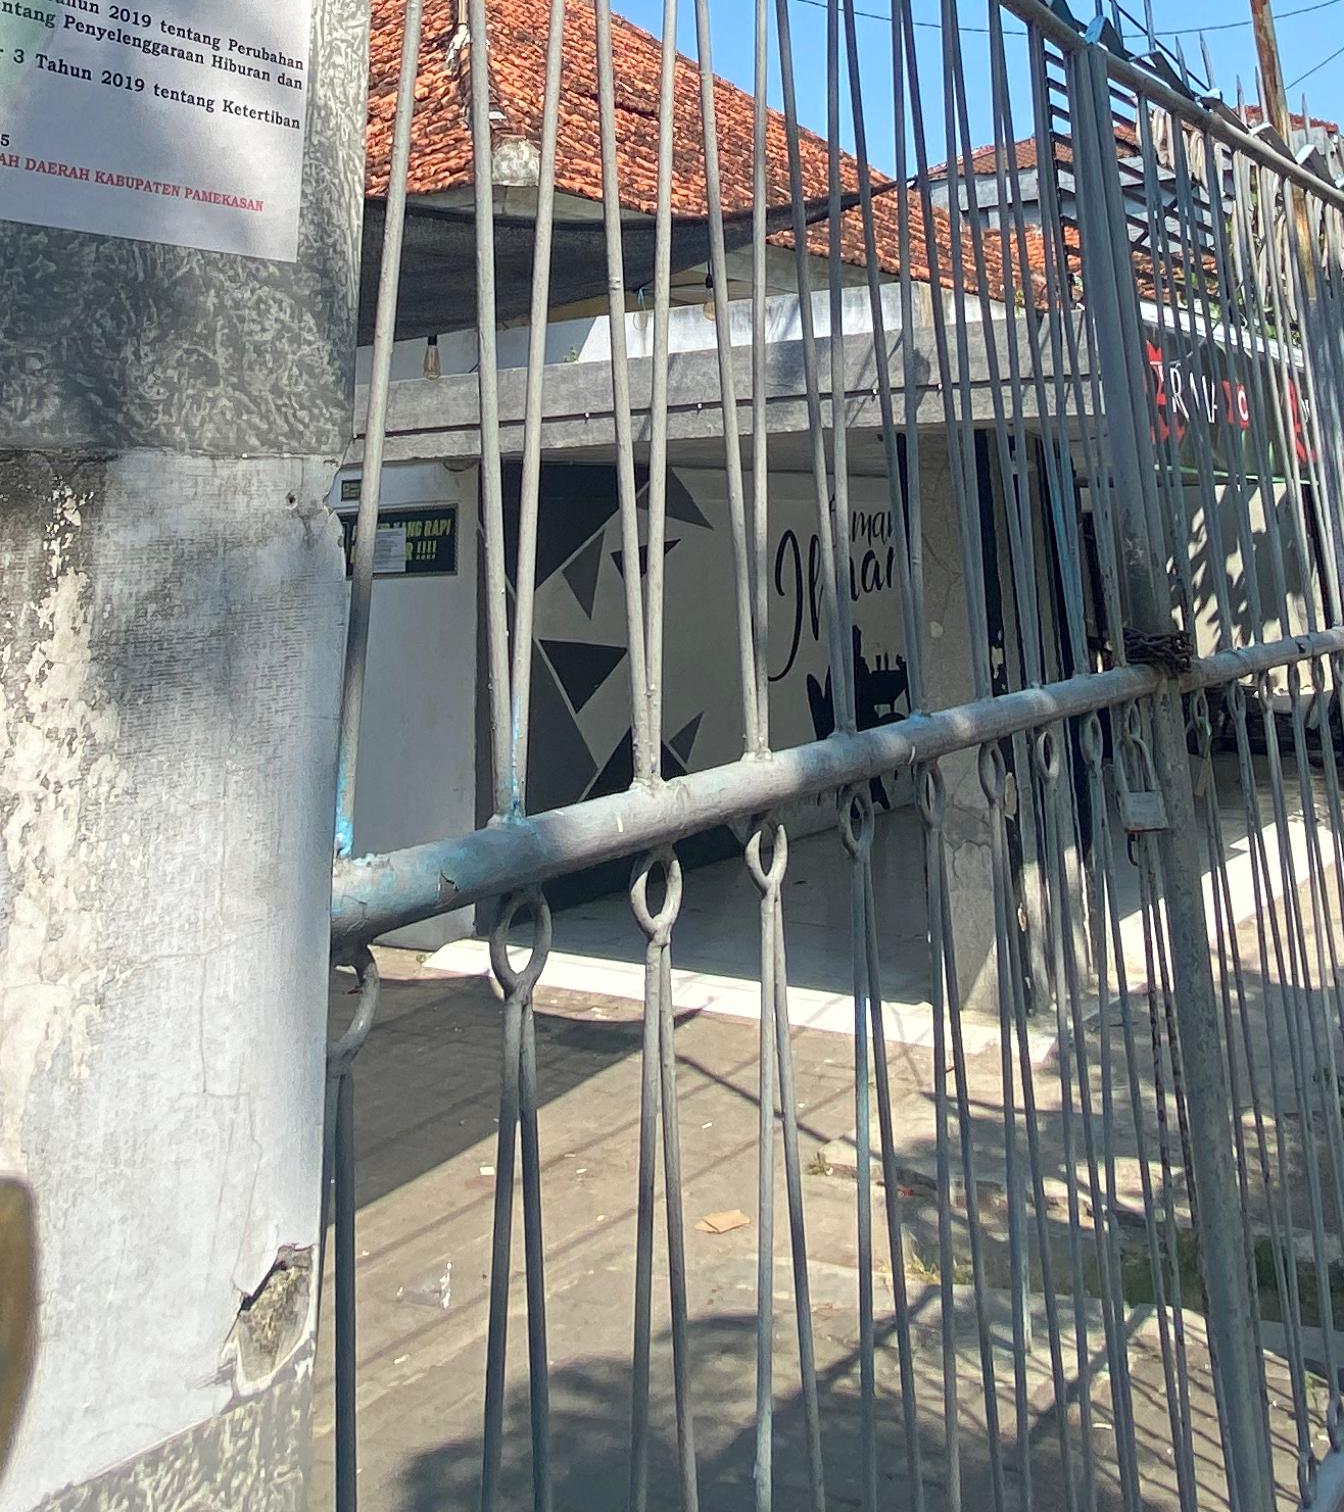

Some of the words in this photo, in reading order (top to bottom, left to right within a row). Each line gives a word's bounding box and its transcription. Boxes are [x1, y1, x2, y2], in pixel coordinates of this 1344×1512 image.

[63, 13, 205, 65] Penyelenggaraan
[211, 53, 271, 82] Hiburan
[277, 72, 303, 91] dan
[108, 4, 152, 28] 2019
[160, 19, 222, 52] tentang
[228, 37, 304, 71] Perubahan
[12, 48, 25, 65] 3
[35, 53, 92, 81] Tahun
[100, 69, 145, 93] 2019
[153, 83, 216, 113] tentang
[222, 99, 301, 130] Ketertiban
[24, 157, 90, 182] DAERAH
[94, 170, 181, 197] KABUPATEN
[184, 186, 264, 212] PAMEKASAN
